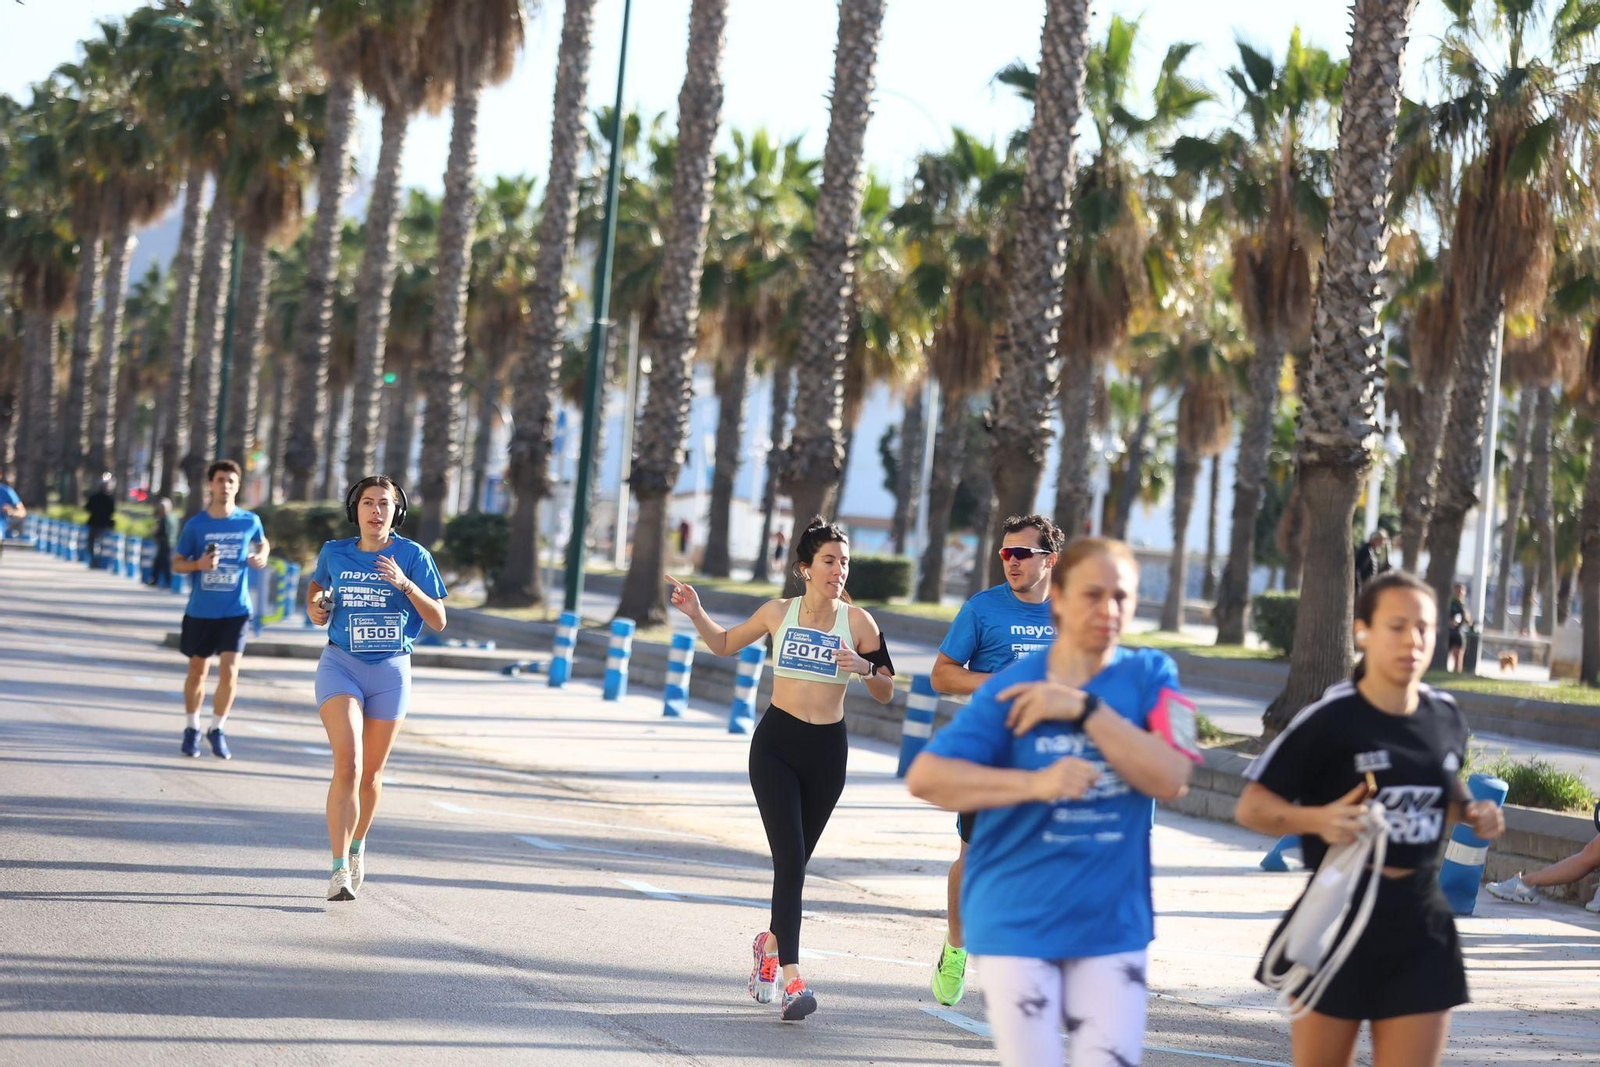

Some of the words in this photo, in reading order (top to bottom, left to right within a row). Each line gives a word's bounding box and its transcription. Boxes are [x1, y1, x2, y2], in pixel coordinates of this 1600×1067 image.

[338, 586, 391, 596] RUNNING
[343, 594, 386, 602] MAKES
[357, 628, 396, 638] 1505
[786, 643, 833, 661] 2014
